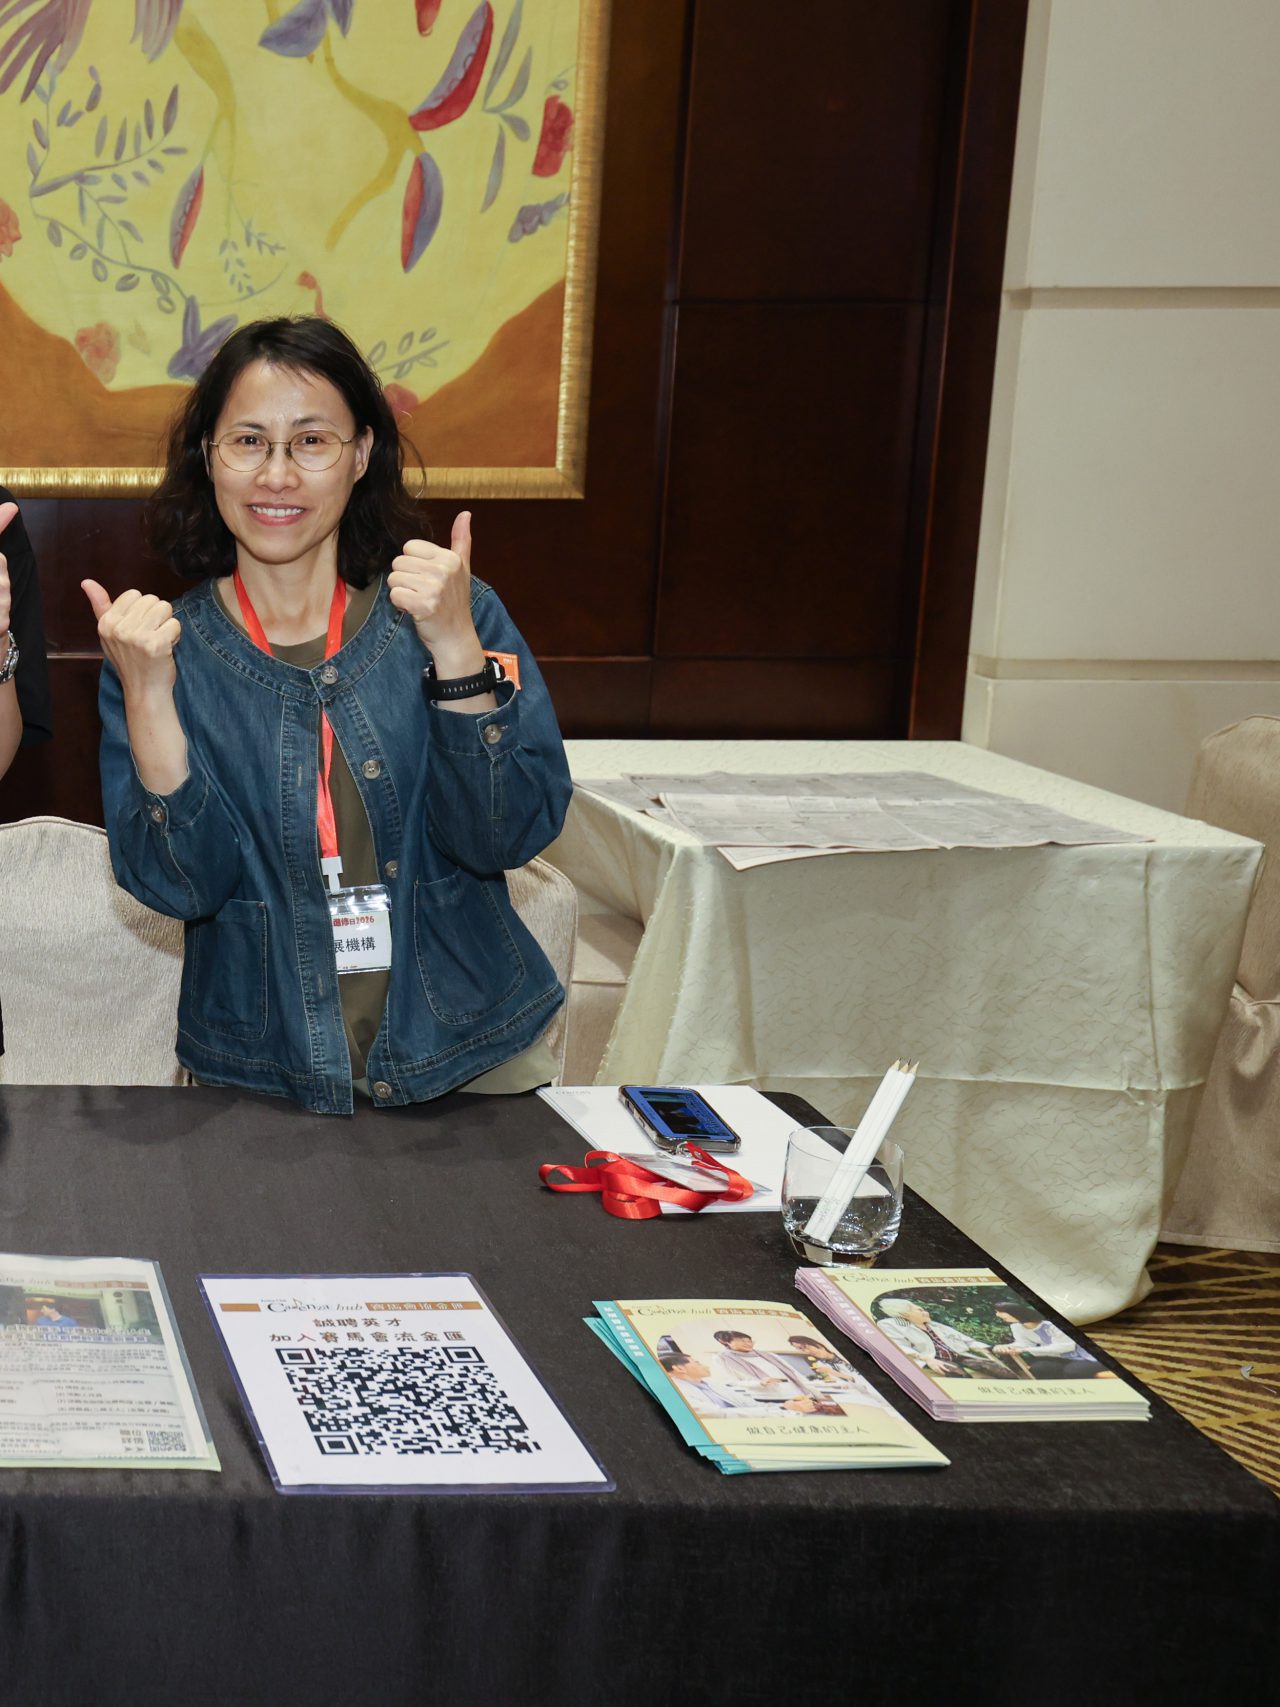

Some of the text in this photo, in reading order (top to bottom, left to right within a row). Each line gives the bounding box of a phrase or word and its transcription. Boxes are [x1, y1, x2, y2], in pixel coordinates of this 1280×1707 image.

[333, 915, 375, 927] 進修日2026
[334, 936, 376, 953] 展機構
[336, 1302, 363, 1311] hub
[313, 1318, 402, 1327] 誠聘英才
[269, 1331, 466, 1343] 加入賽馬會流金匯
